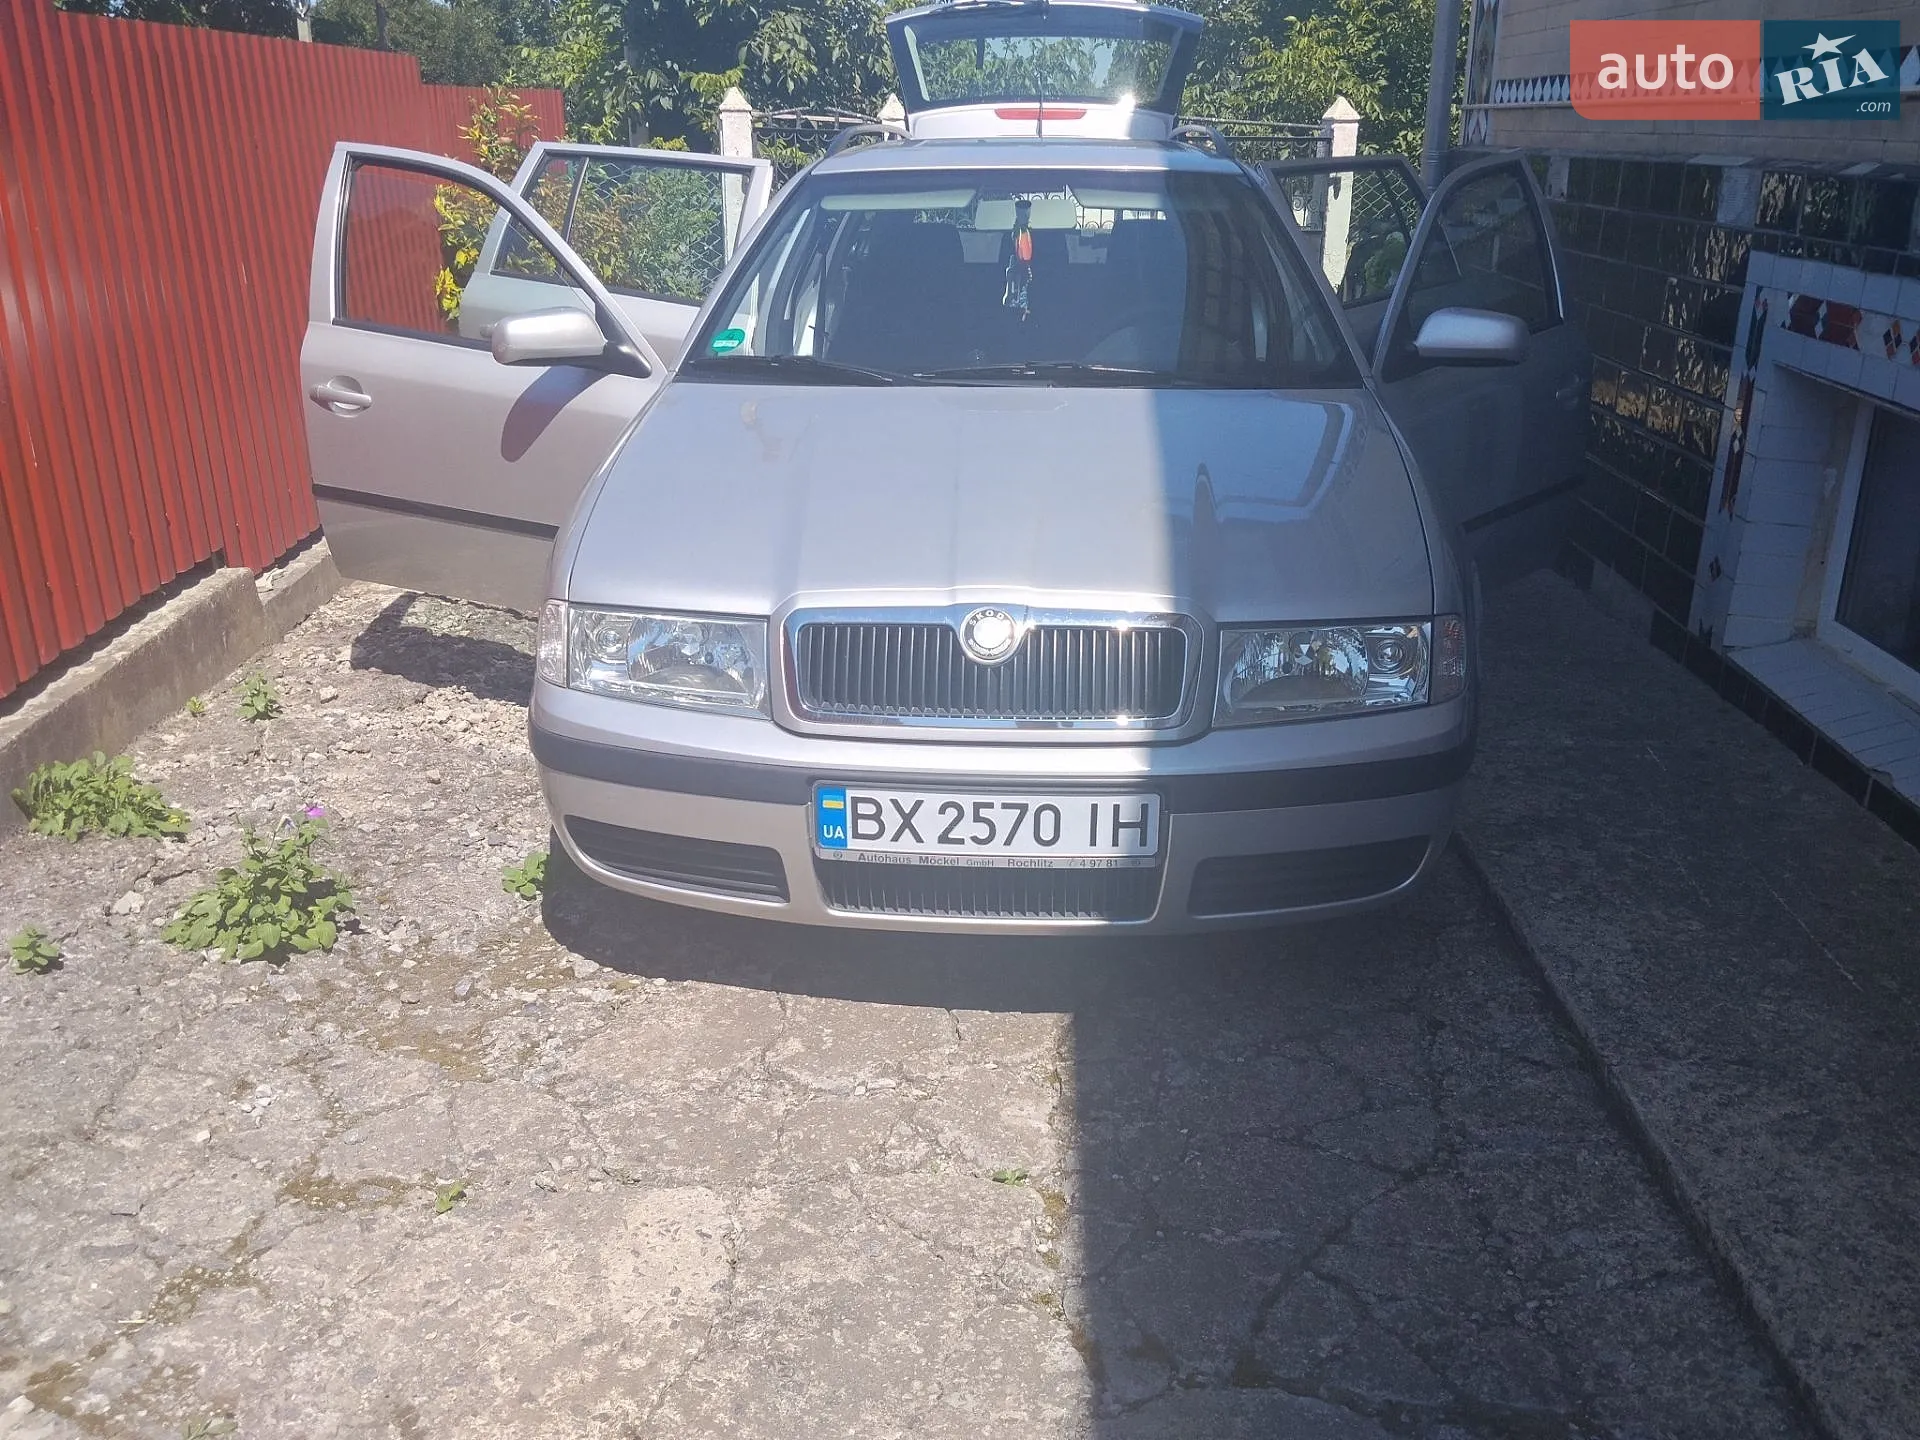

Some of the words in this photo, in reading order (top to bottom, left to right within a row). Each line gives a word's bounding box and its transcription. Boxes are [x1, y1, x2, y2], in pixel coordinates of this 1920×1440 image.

[850, 796, 924, 844] BX
[937, 800, 1062, 847] 2570
[1089, 803, 1150, 848] IH
[823, 825, 844, 839] UA
[858, 852, 912, 864] Autohaus
[919, 856, 960, 866] Möckel
[966, 859, 994, 867] GmbH
[1007, 858, 1053, 868] Rochlitz
